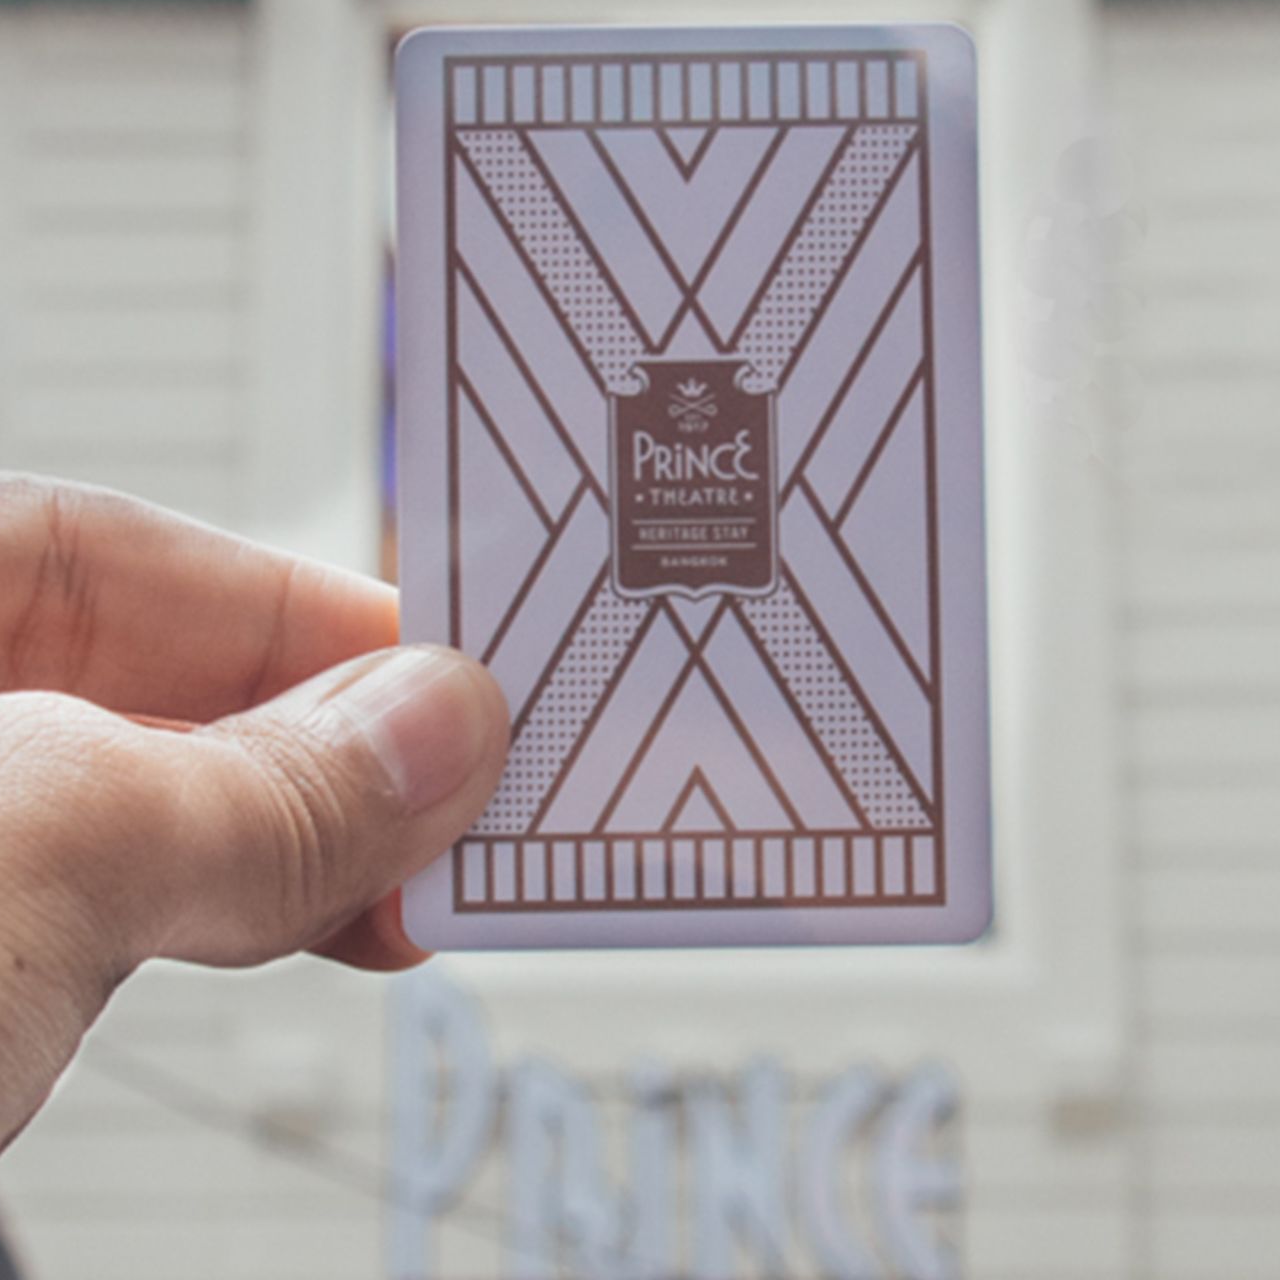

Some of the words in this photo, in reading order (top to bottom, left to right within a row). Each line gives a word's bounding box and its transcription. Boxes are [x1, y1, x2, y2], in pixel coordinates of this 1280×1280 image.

[649, 487, 740, 507] THEATRE
[638, 526, 708, 541] HERITAGE
[712, 525, 749, 540] STAY
[660, 556, 728, 568] BANGKOK
